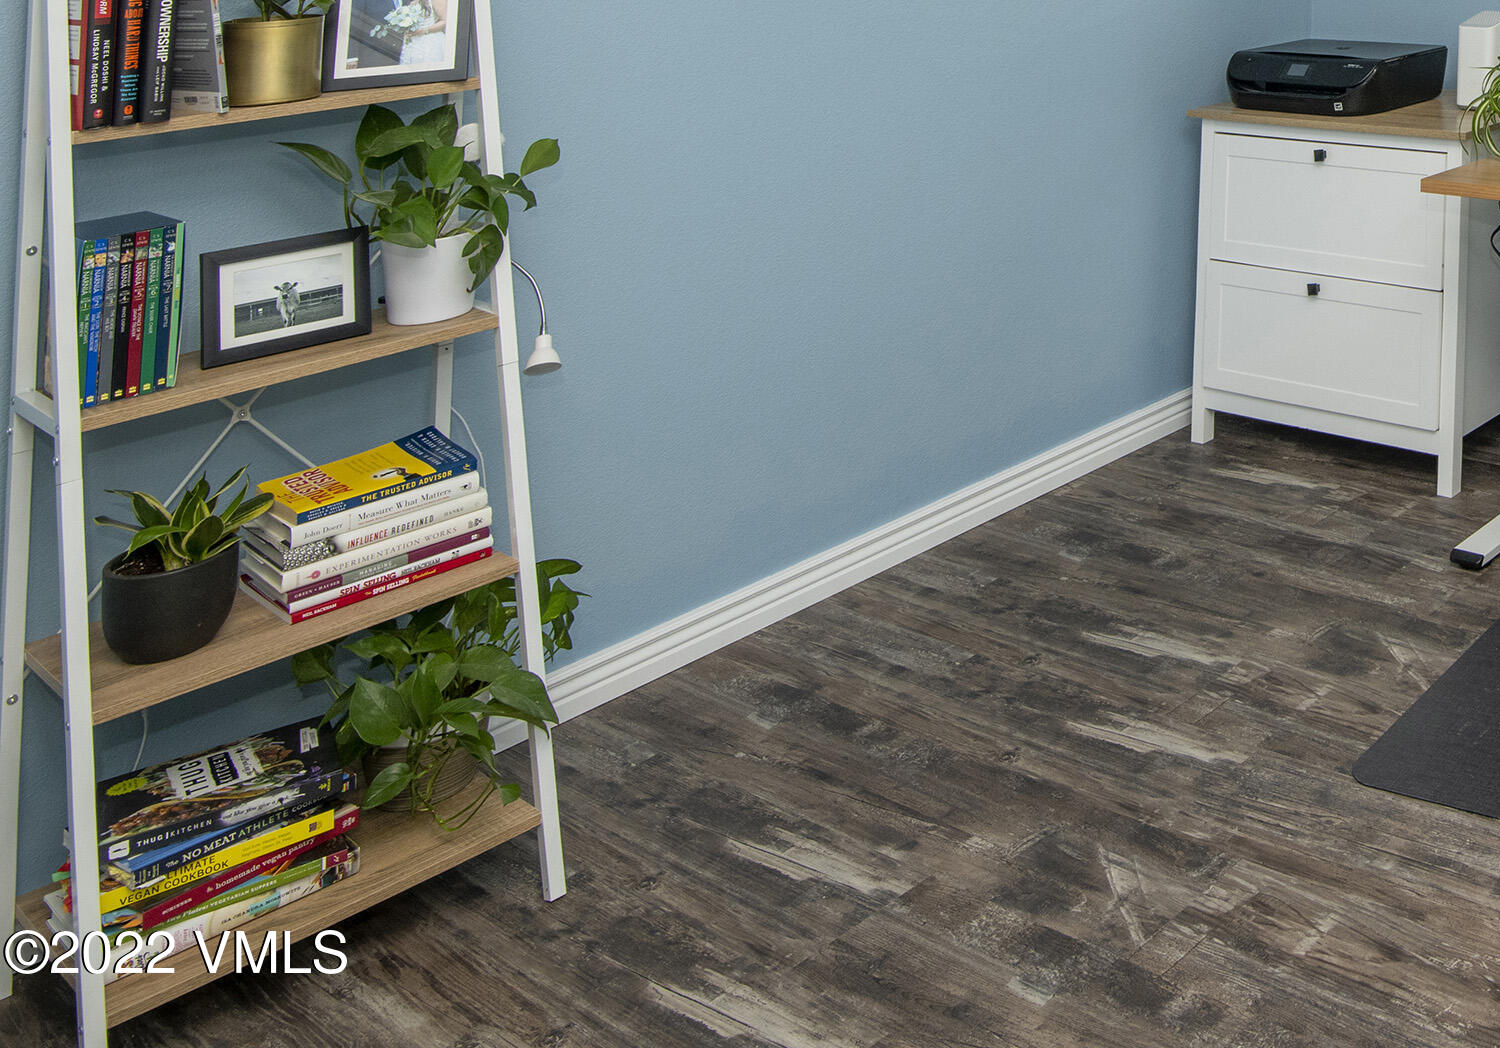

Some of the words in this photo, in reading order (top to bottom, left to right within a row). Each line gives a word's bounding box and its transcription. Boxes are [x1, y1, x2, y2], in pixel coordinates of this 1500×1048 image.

[91, 29, 100, 61] LINDSAY
[126, 19, 141, 41] HARD
[156, 0, 173, 63] OWNERSHIP
[102, 40, 110, 59] NEEL
[123, 43, 139, 70] THINGS
[90, 63, 99, 104] McGREGOR
[361, 493, 377, 503] THE
[380, 482, 417, 498] TRUSTED
[418, 470, 453, 485] ADVISOR
[303, 528, 320, 540] John
[358, 507, 388, 522] Measure
[395, 497, 419, 510] What
[420, 488, 452, 502] Matters
[347, 528, 388, 549] INFLUENCE
[391, 514, 435, 535] REDEFINED
[326, 538, 421, 574] EXPERIMENTATION
[424, 527, 457, 541] WORKS
[340, 584, 361, 597] SPIN
[363, 572, 397, 589] SELLING
[178, 760, 209, 796] THUG
[137, 834, 163, 848] THUG
[170, 819, 212, 837] KITCHEN
[238, 810, 289, 838] ATHLETE
[181, 848, 201, 862] NO
[204, 832, 236, 853] MEAT
[216, 863, 261, 890] homemade
[262, 850, 287, 867] vegan
[288, 837, 315, 855] pantry
[120, 885, 159, 905] VEGAN
[164, 860, 229, 889] COOKBOOK
[251, 880, 277, 893] SUPPERS
